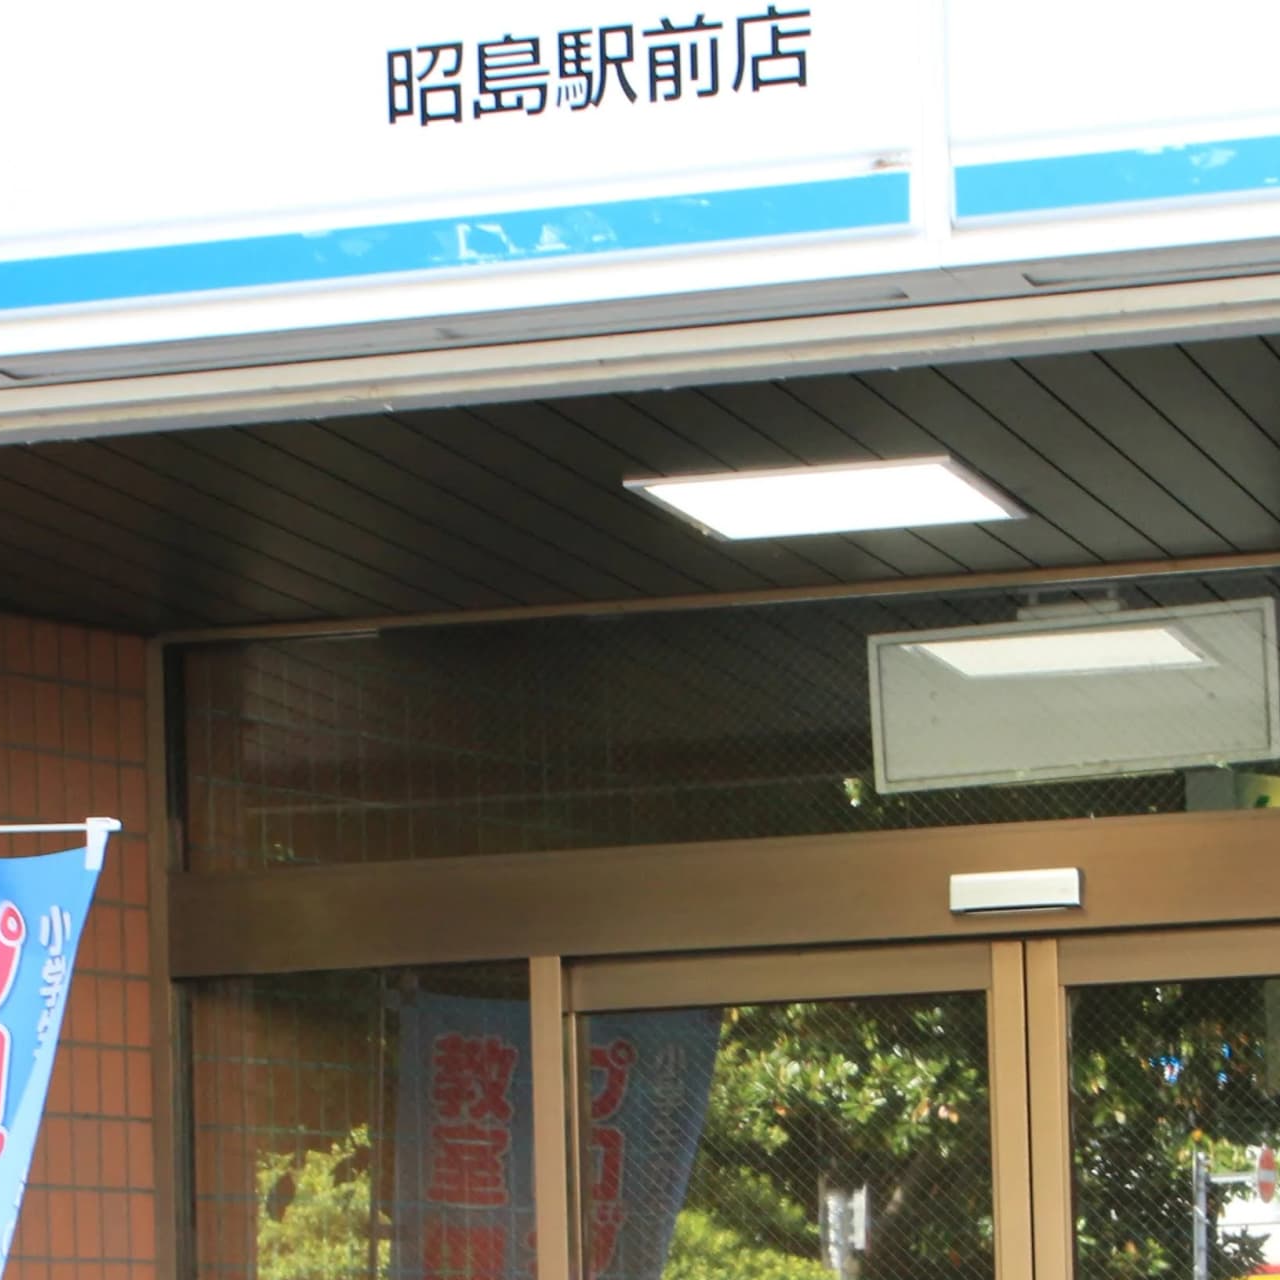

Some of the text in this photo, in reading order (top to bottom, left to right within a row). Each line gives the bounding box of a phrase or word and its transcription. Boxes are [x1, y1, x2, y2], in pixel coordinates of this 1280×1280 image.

[386, 5, 812, 127] 昭島駅前店
